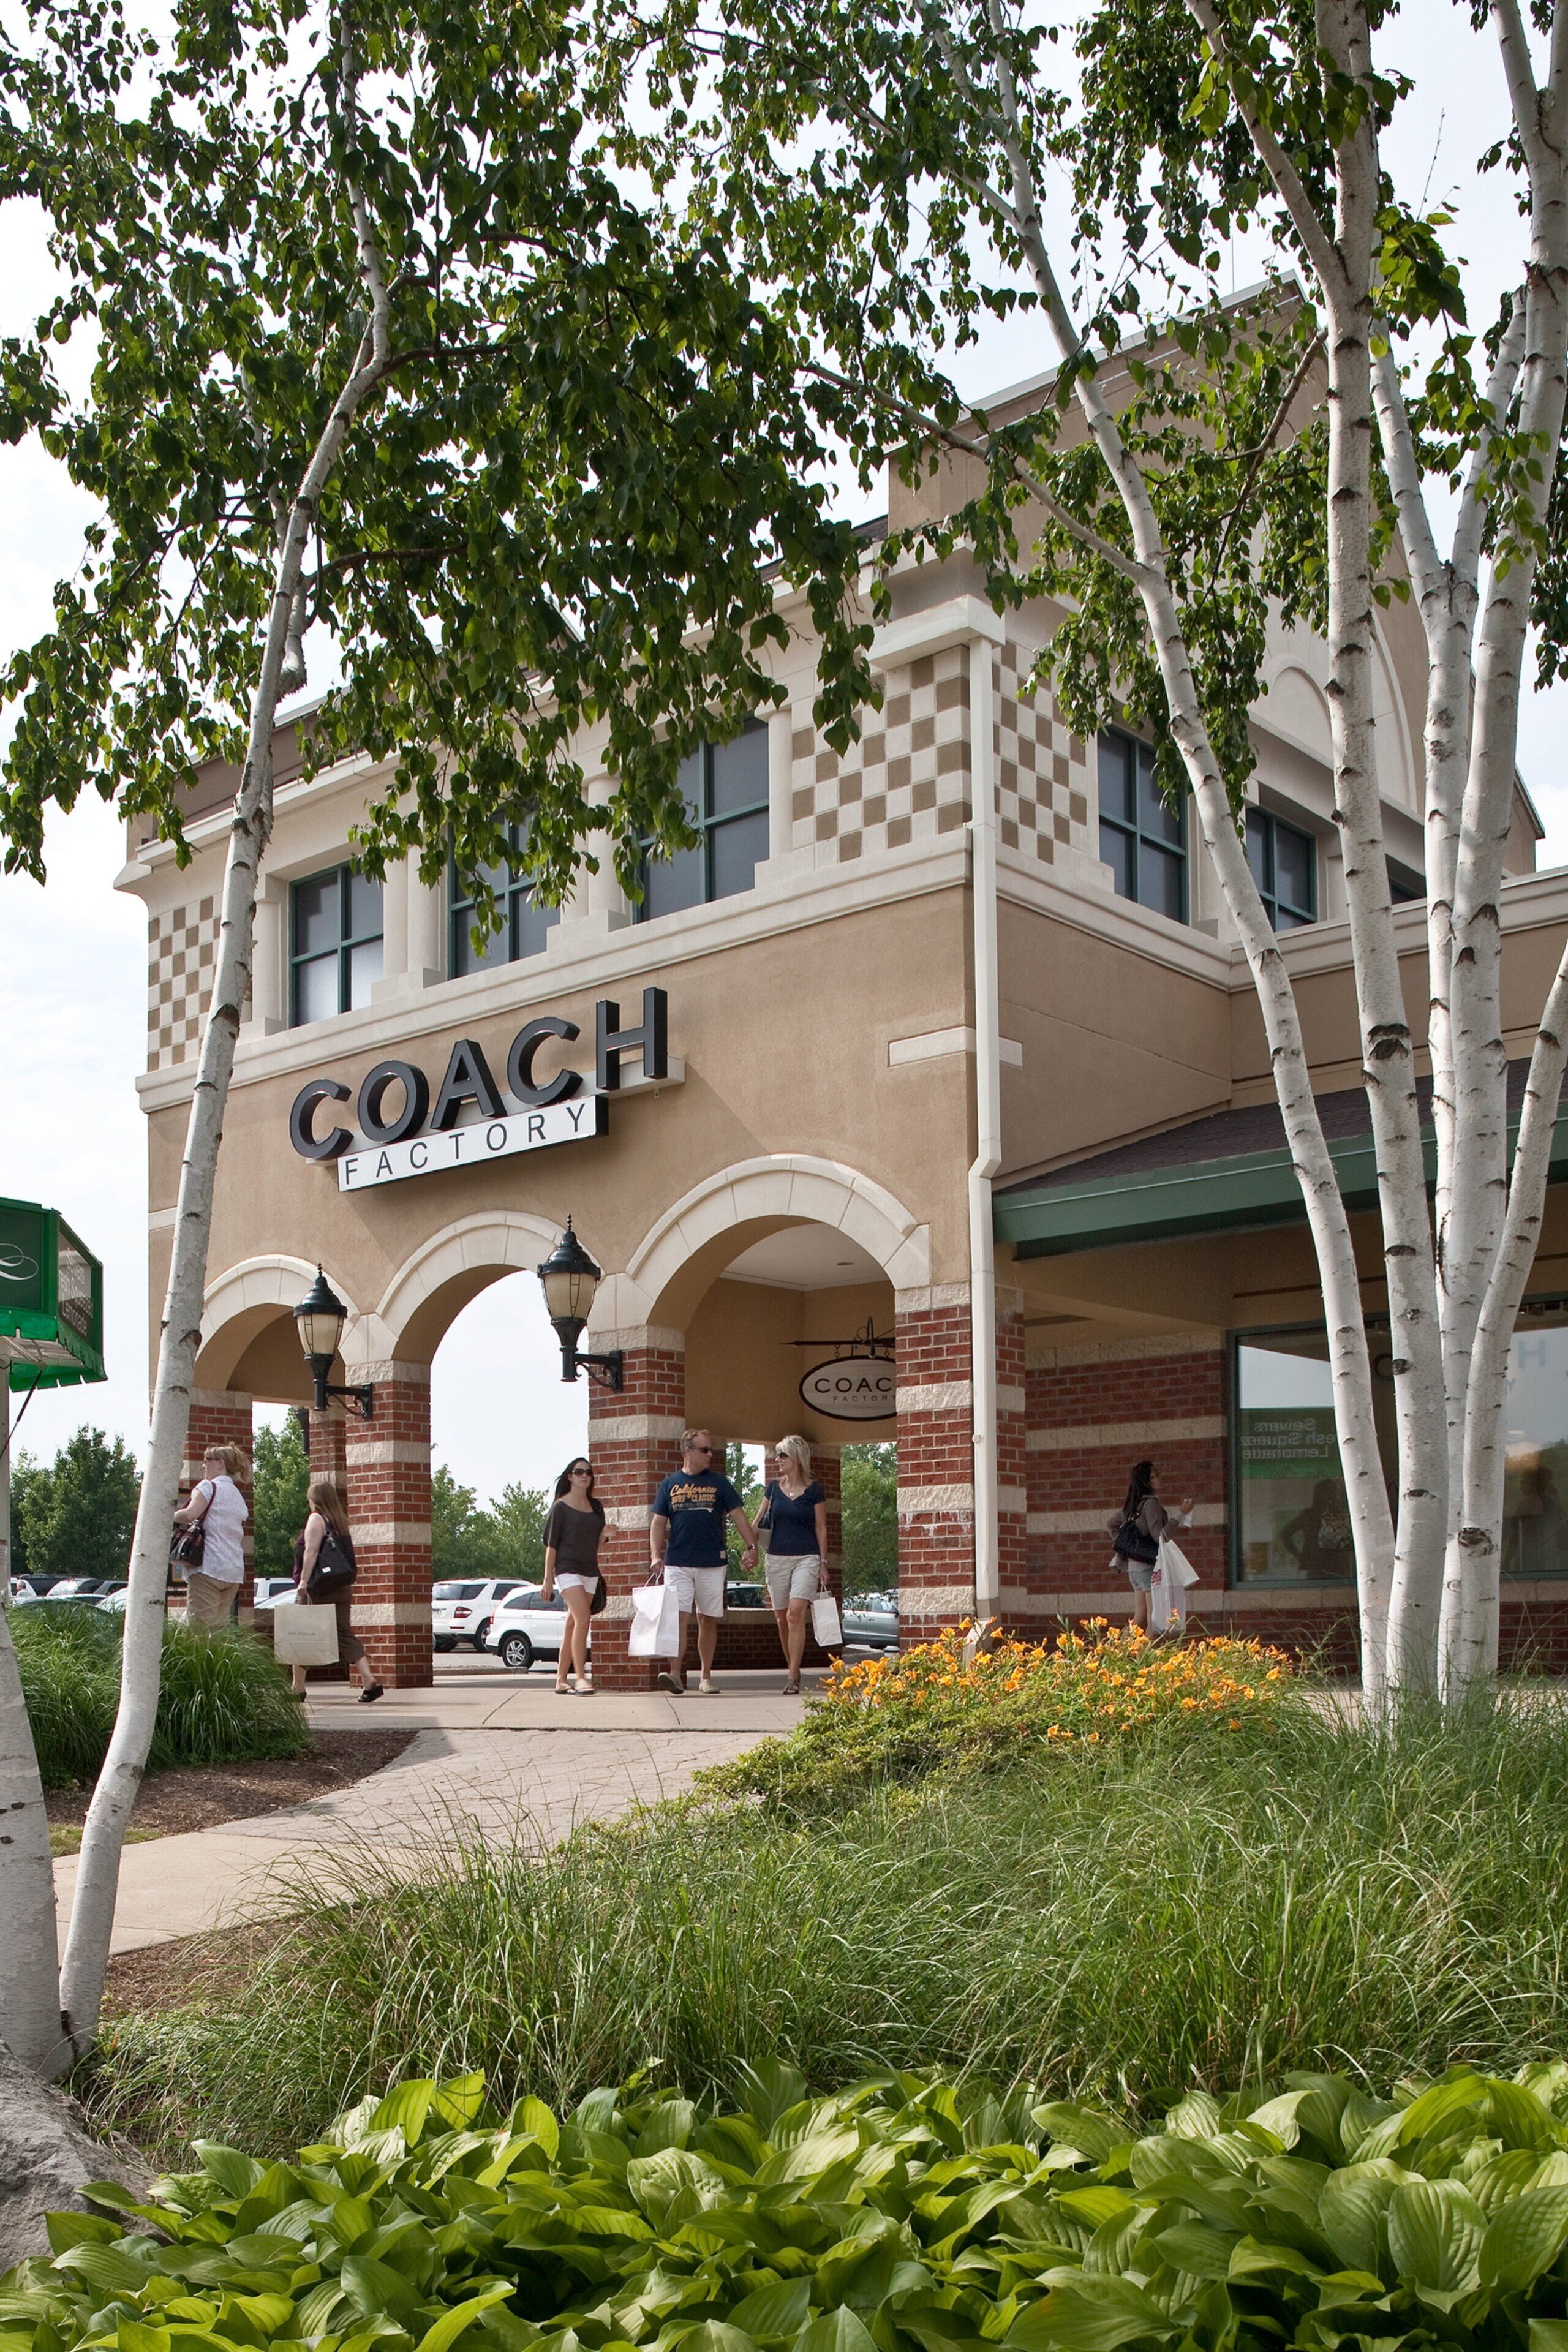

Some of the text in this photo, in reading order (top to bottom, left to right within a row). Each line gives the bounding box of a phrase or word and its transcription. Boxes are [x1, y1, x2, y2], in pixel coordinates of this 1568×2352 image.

[290, 987, 667, 1161] COACH
[345, 1104, 586, 1185] FACTORY
[62, 1294, 88, 1336] Lemonade
[815, 1378, 892, 1393] COAC
[670, 1483, 717, 1498] California
[671, 1495, 686, 1504] SURF
